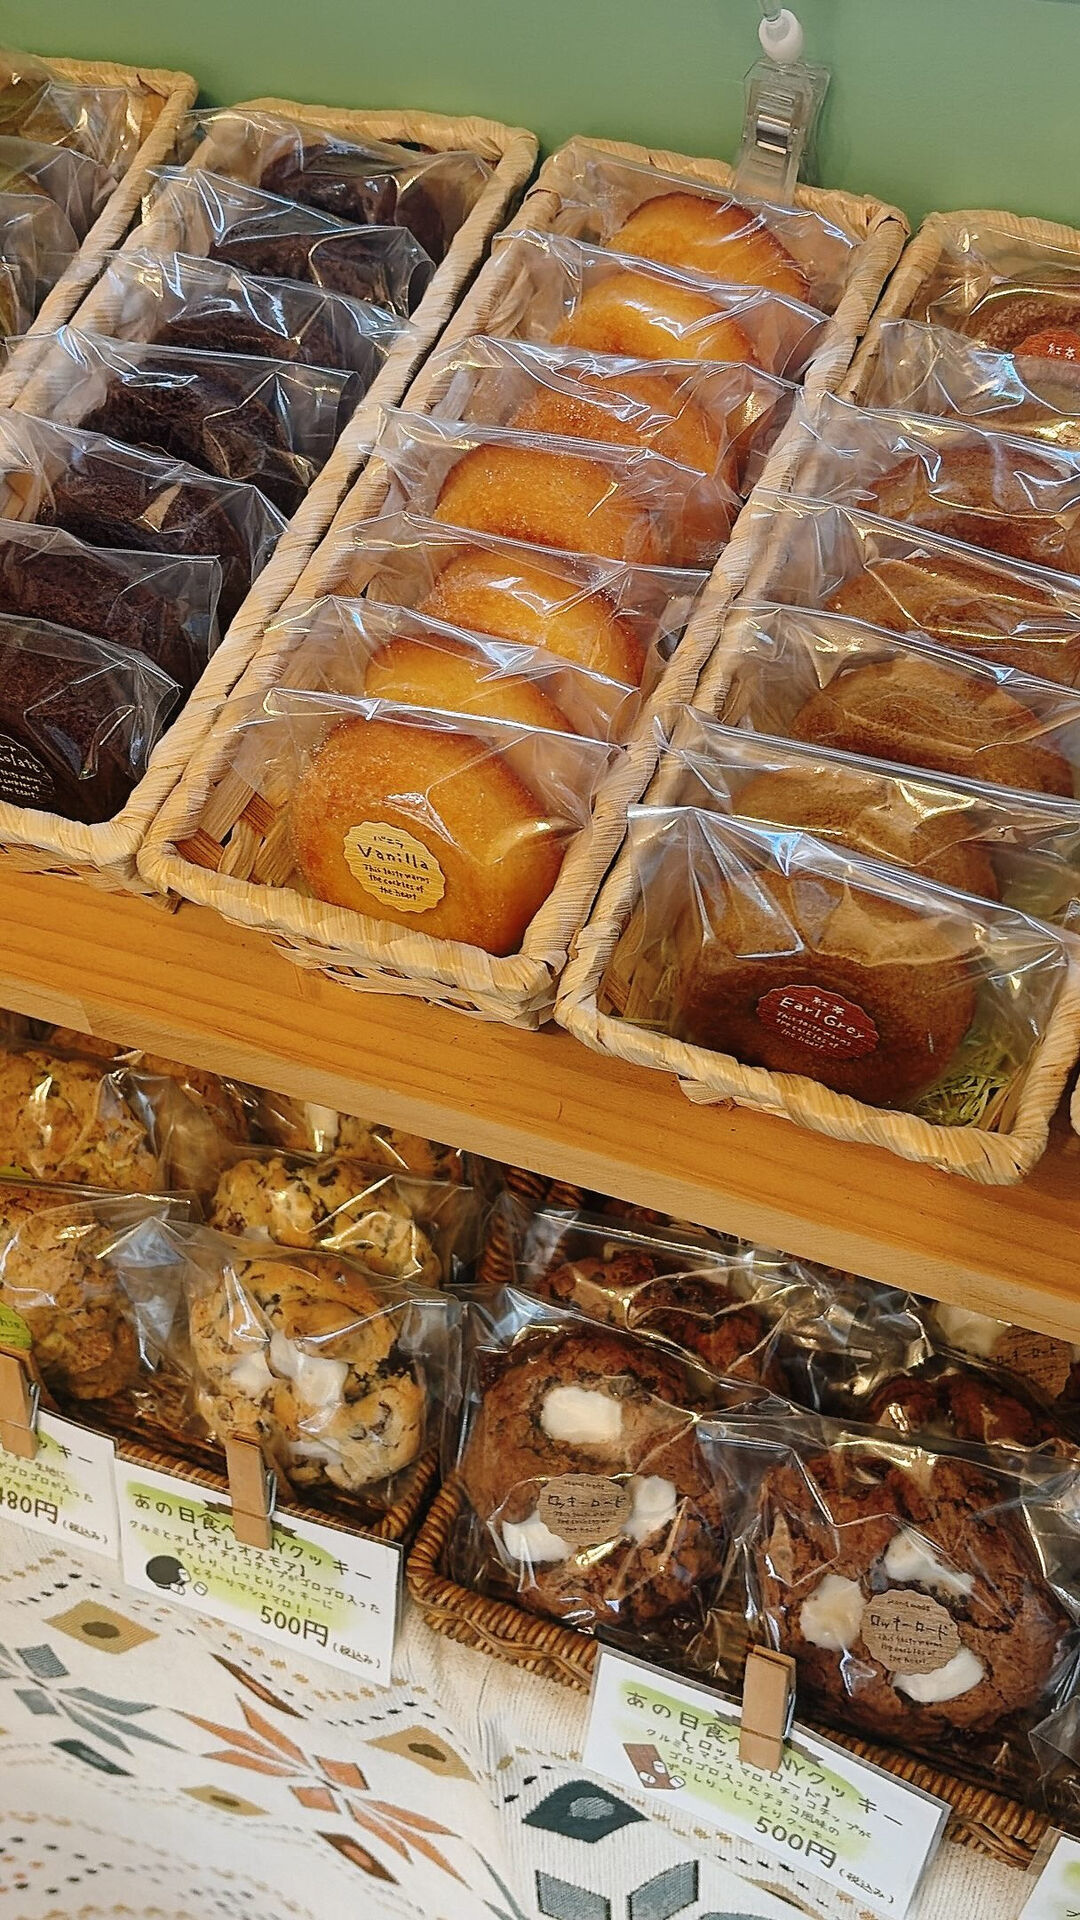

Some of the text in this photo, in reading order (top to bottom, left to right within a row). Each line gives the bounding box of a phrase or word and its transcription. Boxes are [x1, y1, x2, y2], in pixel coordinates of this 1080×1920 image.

[1047, 342, 1076, 360] 紅茶
[373, 835, 404, 849] バニラ
[357, 843, 429, 871] Vanilla
[779, 996, 865, 1039] Earl Grey
[812, 996, 846, 1017] 紅茶
[260, 1604, 382, 1669] 500円 (税込み)
[870, 1614, 955, 1641] ロッキーロード
[753, 1815, 895, 1905] 500円 (税込み)
